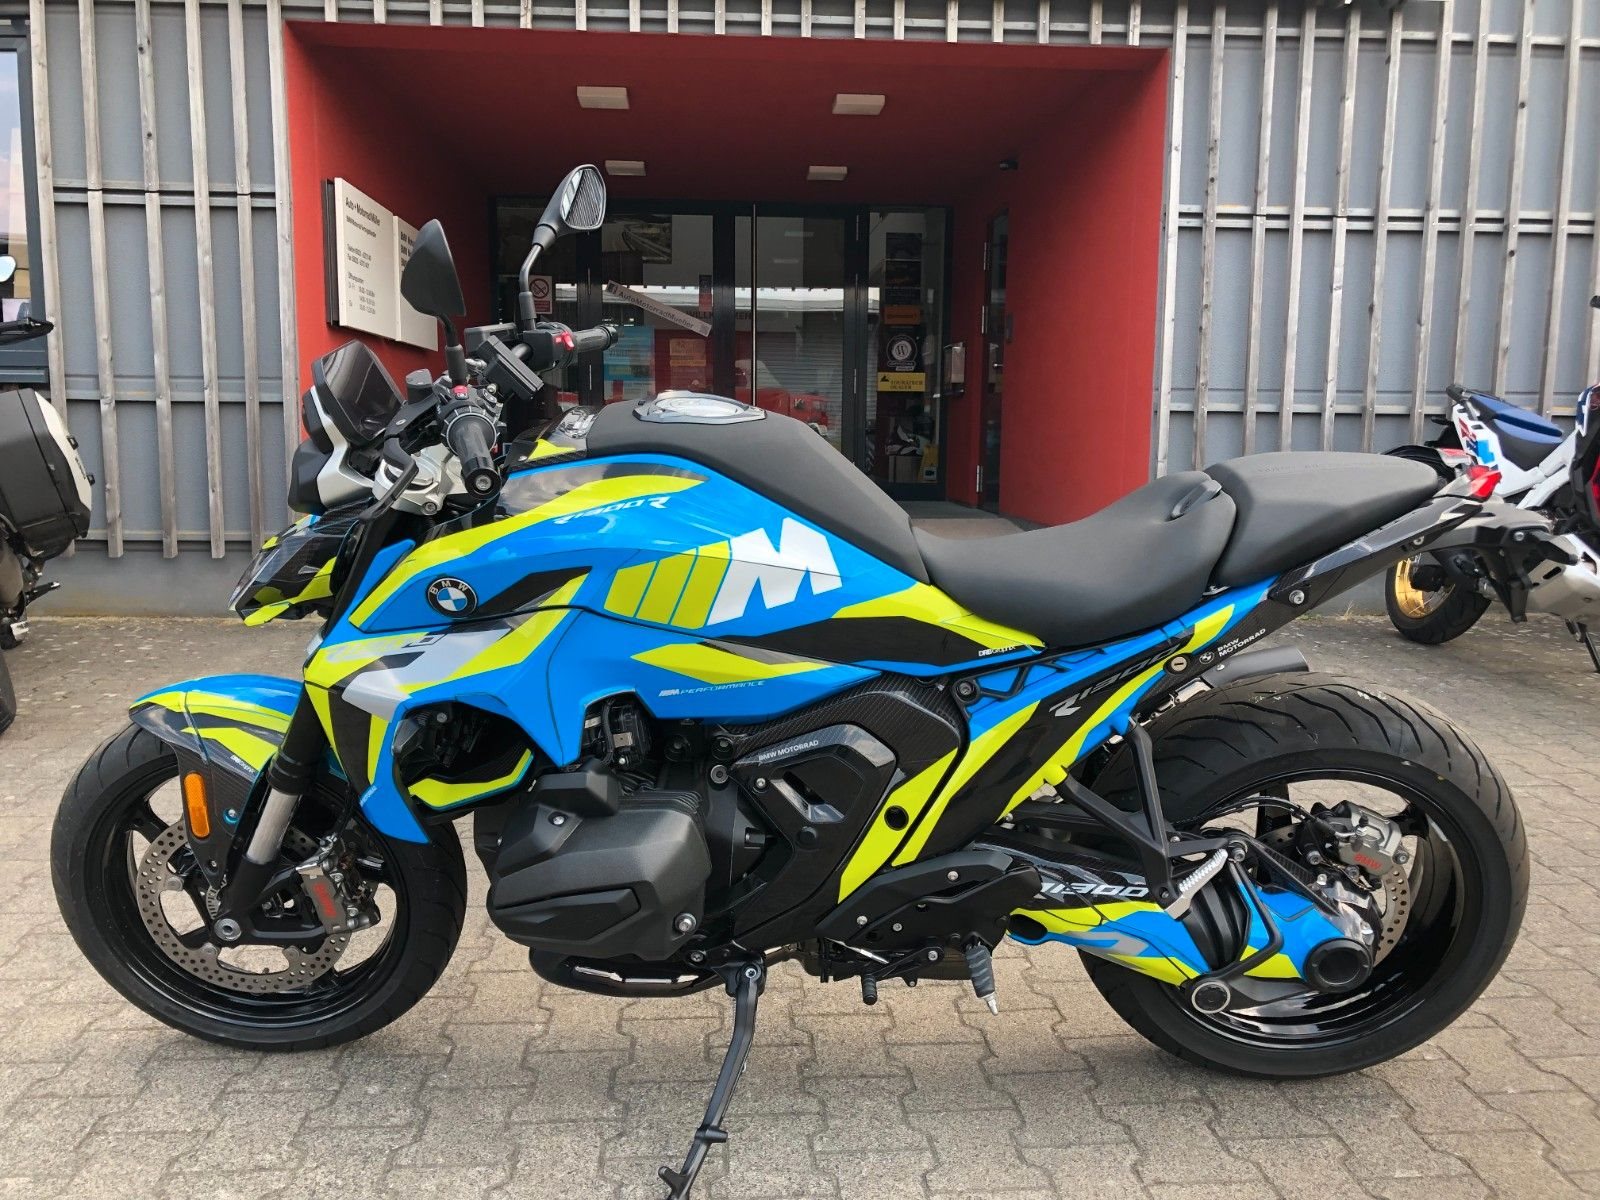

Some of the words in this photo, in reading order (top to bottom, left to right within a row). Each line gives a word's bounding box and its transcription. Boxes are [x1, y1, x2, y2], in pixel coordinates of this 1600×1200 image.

[430, 580, 469, 595] BMW
[1217, 638, 1239, 652] BMW
[1219, 628, 1266, 657] MOTORRAD
[758, 750, 777, 762] BMW
[777, 739, 819, 755] MOTORRAD
